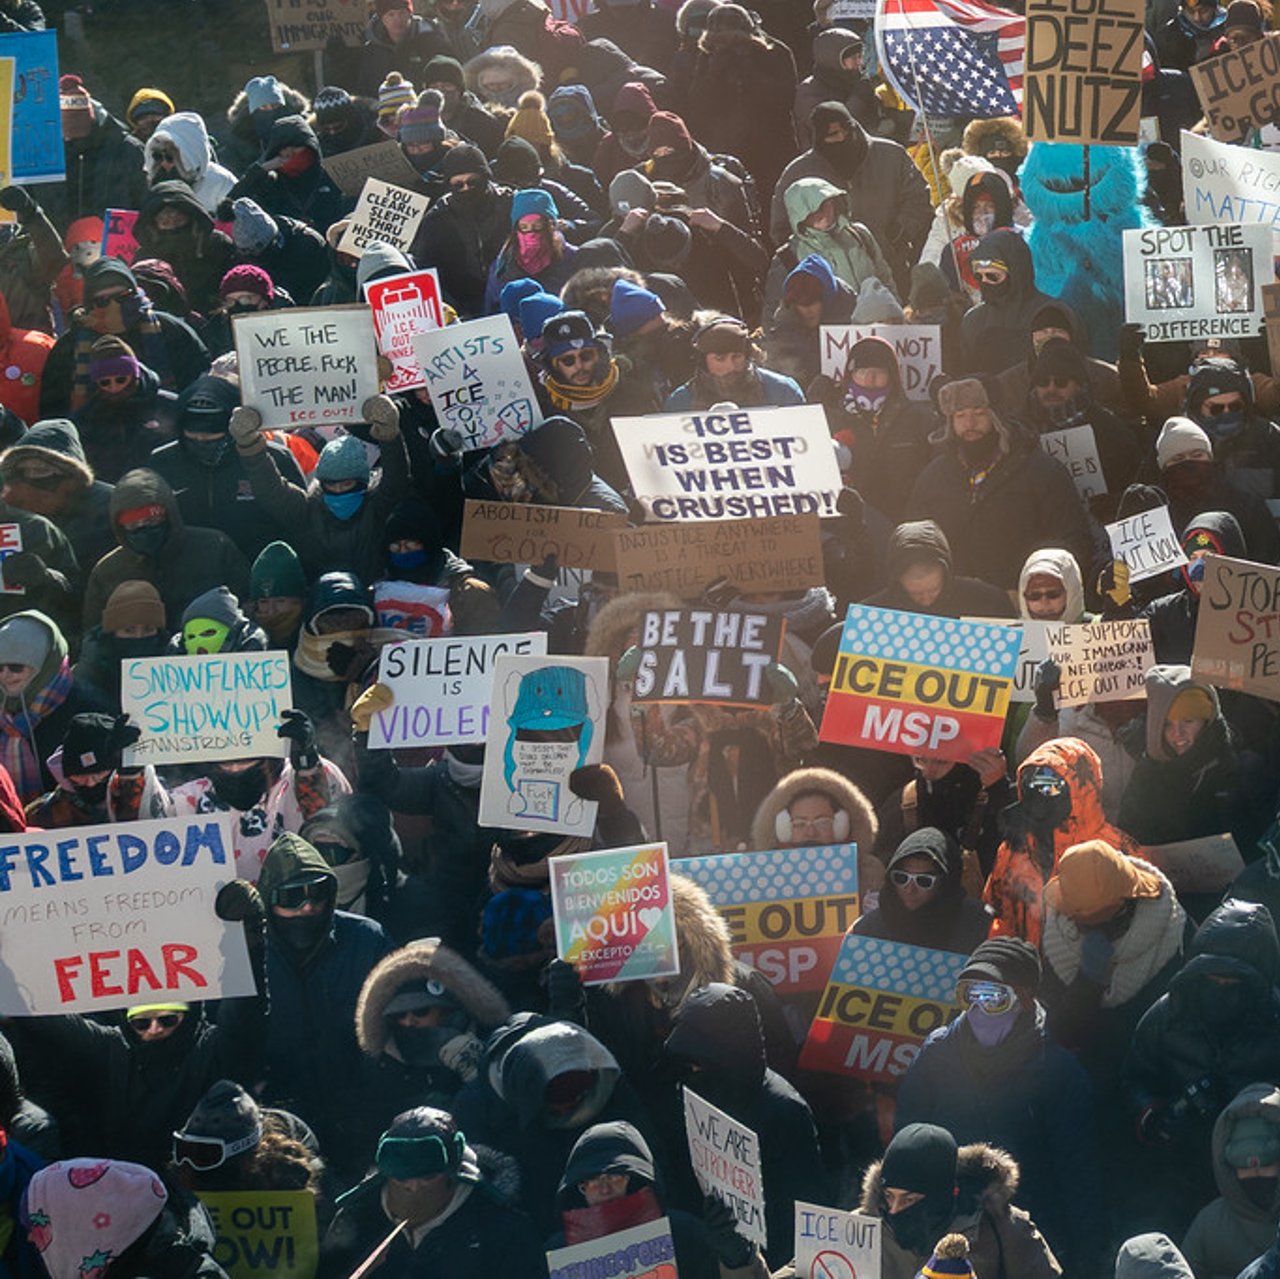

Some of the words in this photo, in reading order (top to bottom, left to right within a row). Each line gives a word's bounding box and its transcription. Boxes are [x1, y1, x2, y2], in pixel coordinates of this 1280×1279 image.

[1027, 16, 1142, 73] DEEZ
[1026, 77, 1139, 141] NUTZ
[1140, 227, 1194, 253] SPOT
[1202, 225, 1245, 248] THE
[256, 330, 292, 348] WE
[300, 325, 338, 344] THE
[1147, 319, 1251, 340] DIFFERENCE
[268, 387, 305, 406] THE
[690, 413, 752, 437] ICE
[656, 443, 700, 466] IS
[709, 439, 795, 462] BEST
[675, 467, 795, 491] WHEN
[652, 494, 834, 519] CRUSHED!
[643, 612, 682, 648] BE
[691, 614, 766, 649] THE
[129, 659, 290, 697] SNOWFLAKES
[834, 655, 903, 696] ICE
[914, 672, 1008, 714] OUT
[862, 706, 959, 749] MSP
[0, 822, 226, 891] FREEDOM
[562, 867, 617, 888] TODOS
[621, 861, 658, 880] SON
[3, 897, 89, 926] MEANS
[104, 886, 202, 912] FREEDOM
[564, 884, 661, 911] BIENVENIDOS
[74, 917, 147, 939] FROM
[569, 903, 638, 945] AQUÍ
[581, 945, 632, 961] EXCEPTO
[55, 945, 206, 1003] FEAR
